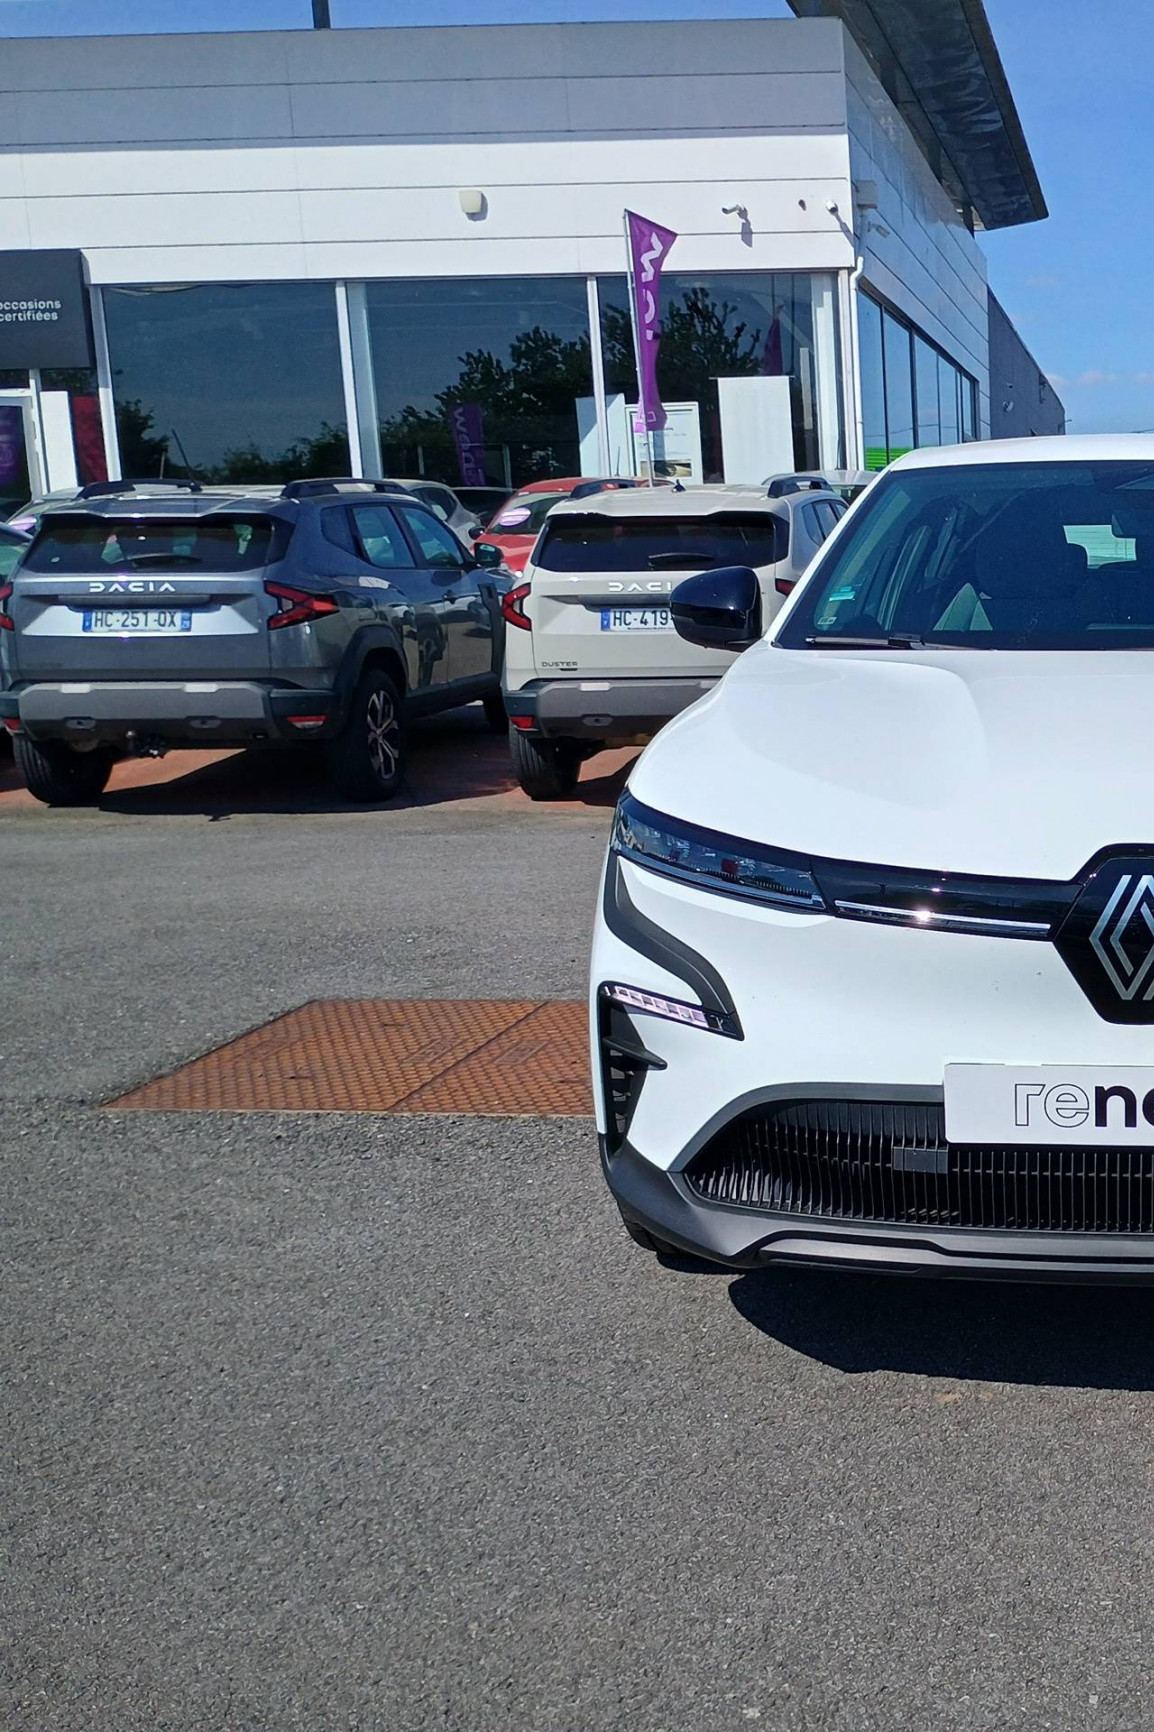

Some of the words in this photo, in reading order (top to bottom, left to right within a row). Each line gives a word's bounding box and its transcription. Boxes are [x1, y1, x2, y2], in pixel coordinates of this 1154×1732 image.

[89, 582, 176, 593] DACIA
[608, 582, 673, 592] DACI
[613, 610, 674, 627] HC-419
